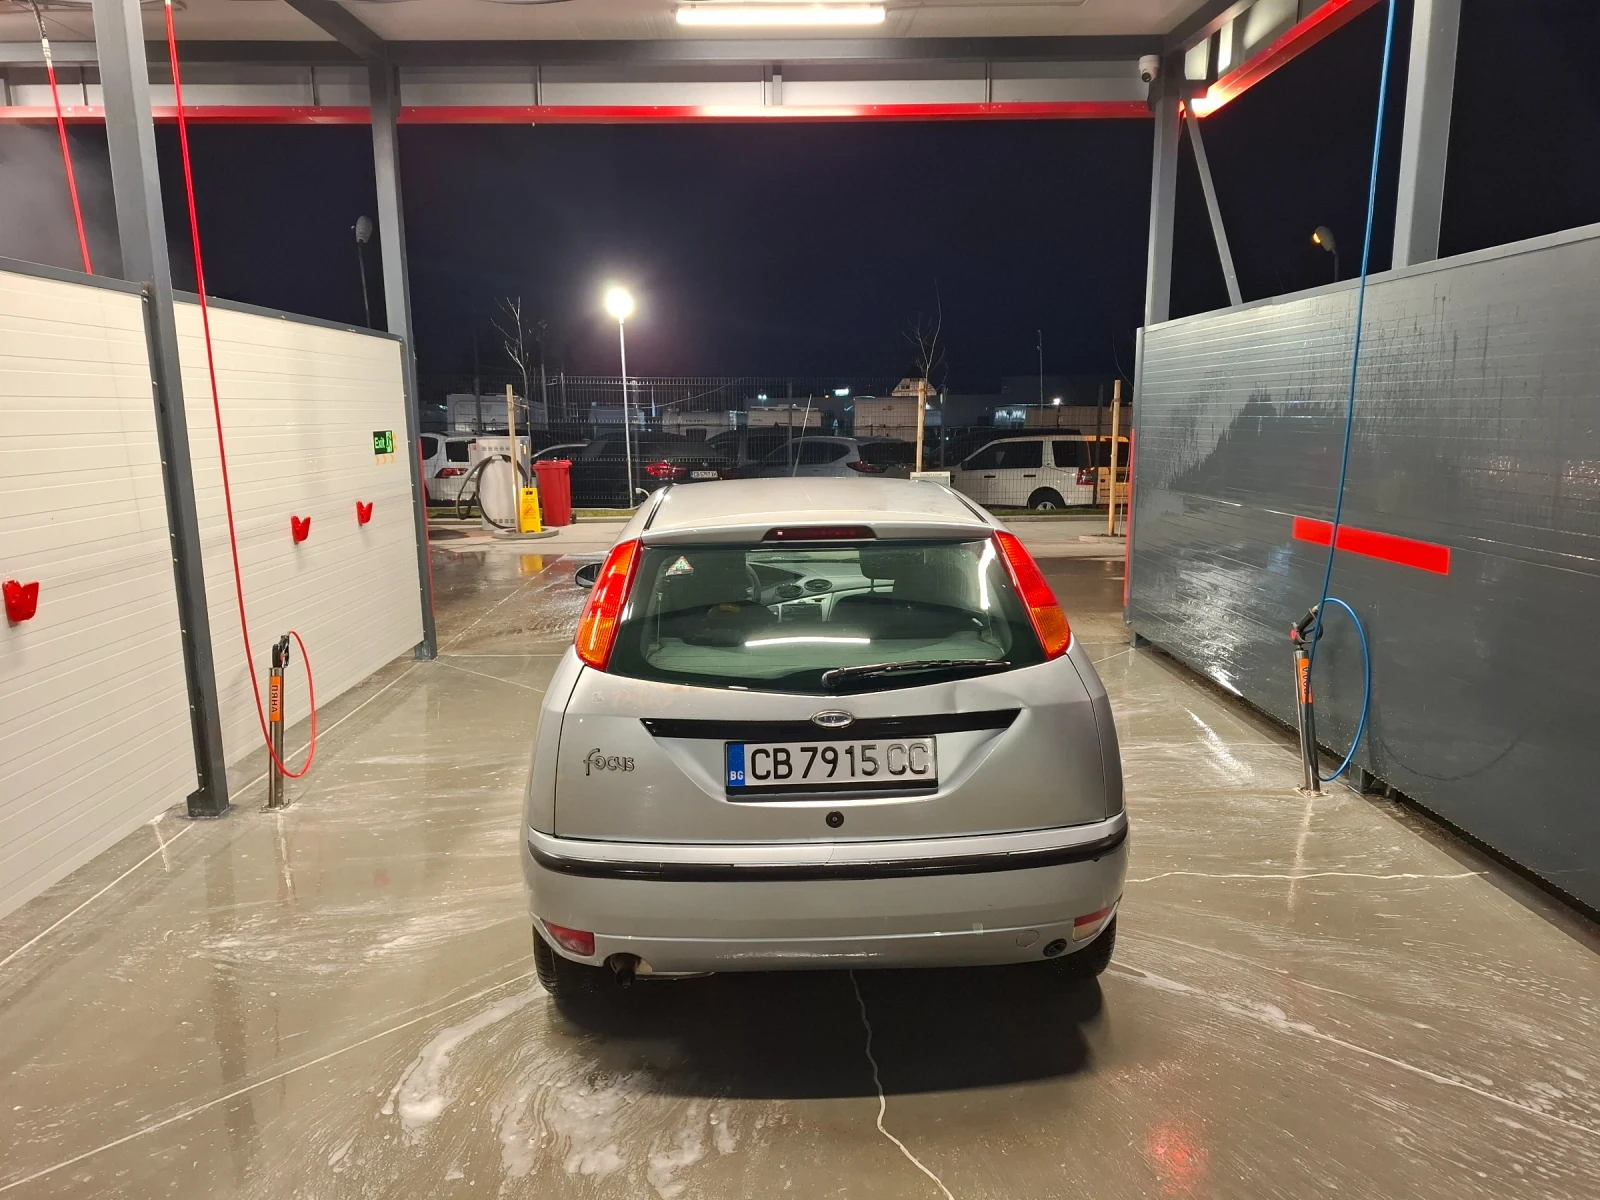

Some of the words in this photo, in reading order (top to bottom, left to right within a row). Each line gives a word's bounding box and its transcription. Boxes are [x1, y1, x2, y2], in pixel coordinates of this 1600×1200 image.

[374, 436, 386, 449] Exit
[271, 684, 279, 713] ПЯНА
[730, 770, 744, 781] BG
[750, 747, 793, 781] CB
[800, 744, 880, 779] 7915
[886, 742, 929, 776] CC
